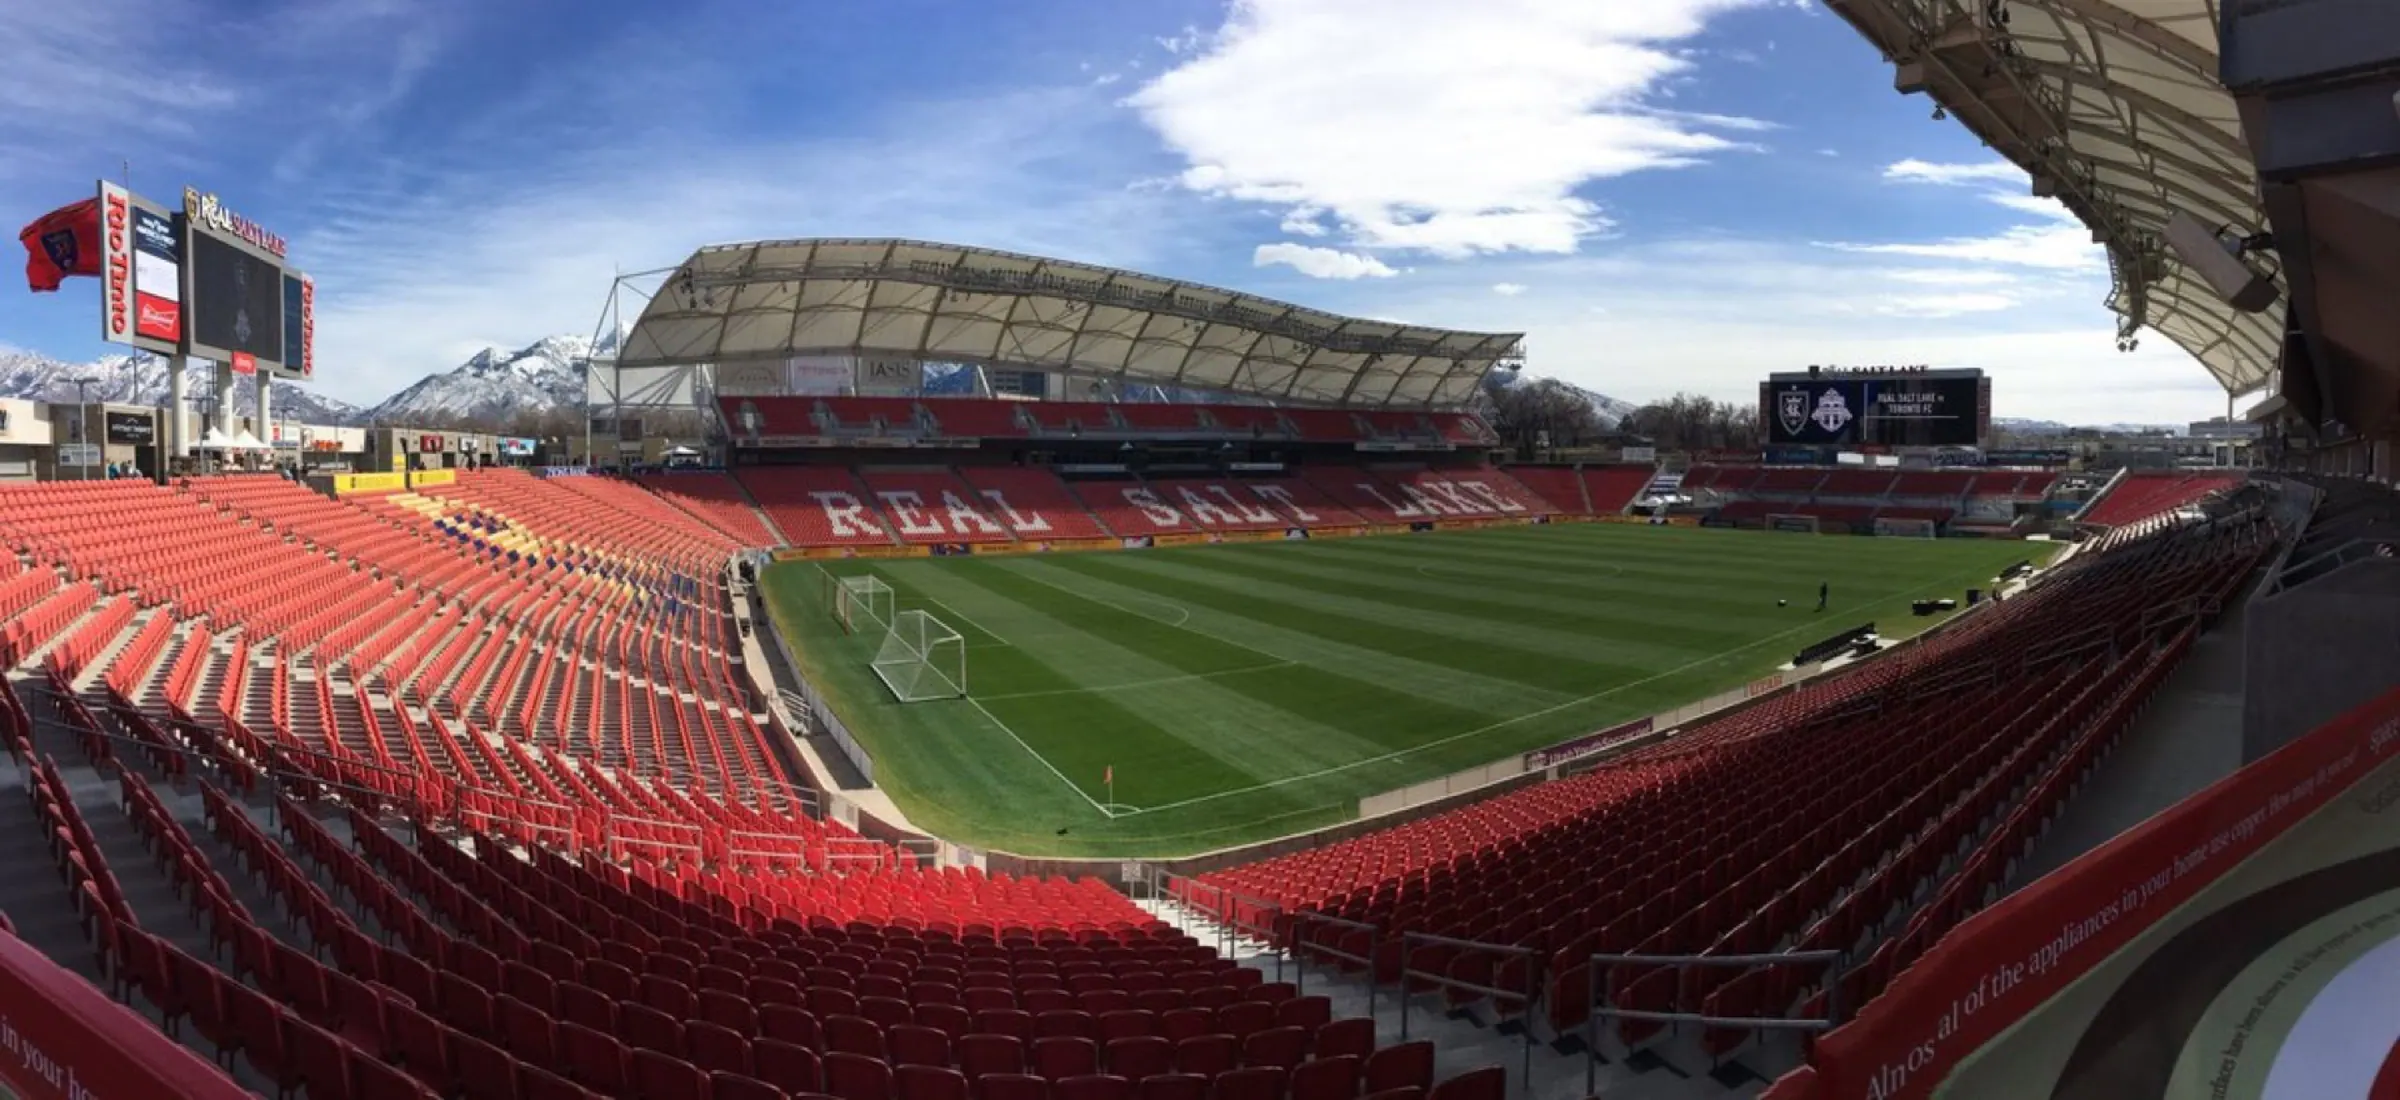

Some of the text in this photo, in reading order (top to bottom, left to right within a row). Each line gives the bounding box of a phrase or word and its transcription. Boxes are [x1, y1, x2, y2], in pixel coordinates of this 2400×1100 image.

[809, 480, 1527, 537] REAL SALT LAKE
[1963, 974, 1988, 1016] of
[1991, 961, 2025, 999] the
[2028, 900, 2119, 975] appliances
[2122, 887, 2138, 913] in
[2139, 866, 2172, 908] your
[2, 1014, 100, 1100] in your ho
